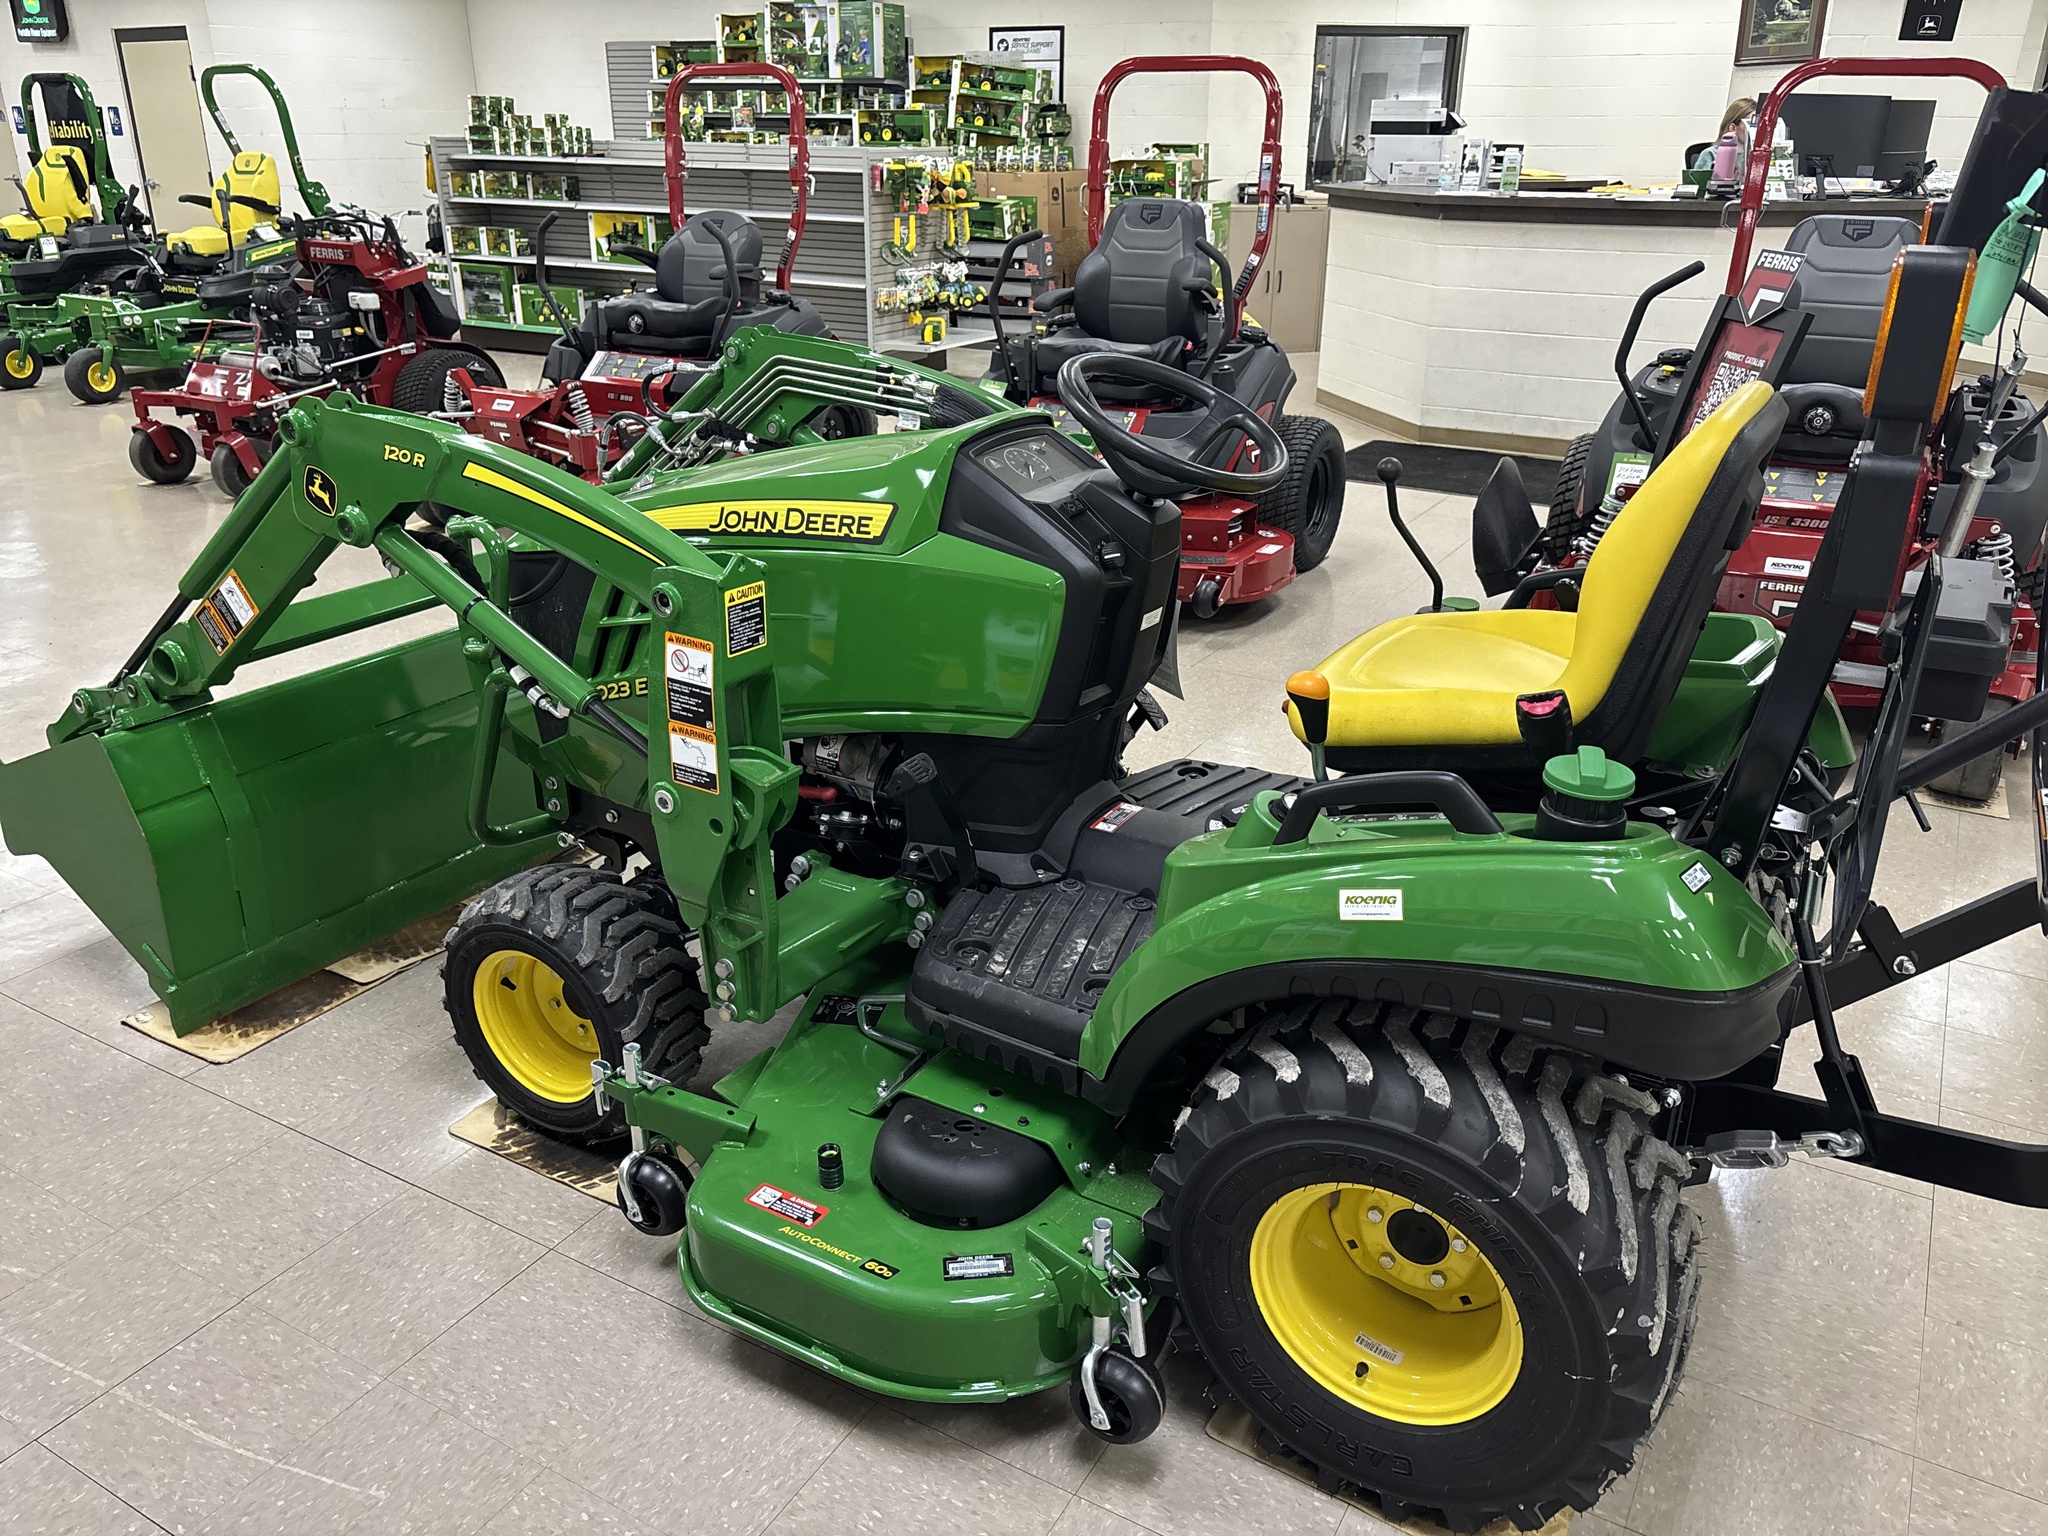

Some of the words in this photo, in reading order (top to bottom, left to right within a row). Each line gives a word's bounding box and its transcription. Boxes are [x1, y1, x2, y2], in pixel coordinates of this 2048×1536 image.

[310, 246, 345, 260] FERRIS
[1757, 252, 1801, 272] FERRIS
[164, 284, 178, 293] JOHN
[179, 286, 196, 294] DEERE
[1724, 350, 1745, 362] PRODUCT
[1746, 356, 1765, 368] CATALOG
[384, 445, 411, 464] 120
[412, 454, 426, 468] R
[709, 507, 778, 530] JOHN
[784, 508, 874, 535] DEERE
[1764, 516, 1790, 526] ISX
[1791, 518, 1830, 528] 3300
[737, 584, 763, 600] CAUTION
[674, 635, 711, 652] WARNING
[678, 726, 714, 742] WARNING
[795, 1196, 818, 1210] DANGER
[1322, 1151, 1425, 1188] TRAC
[1445, 1197, 1542, 1290] CHIEF
